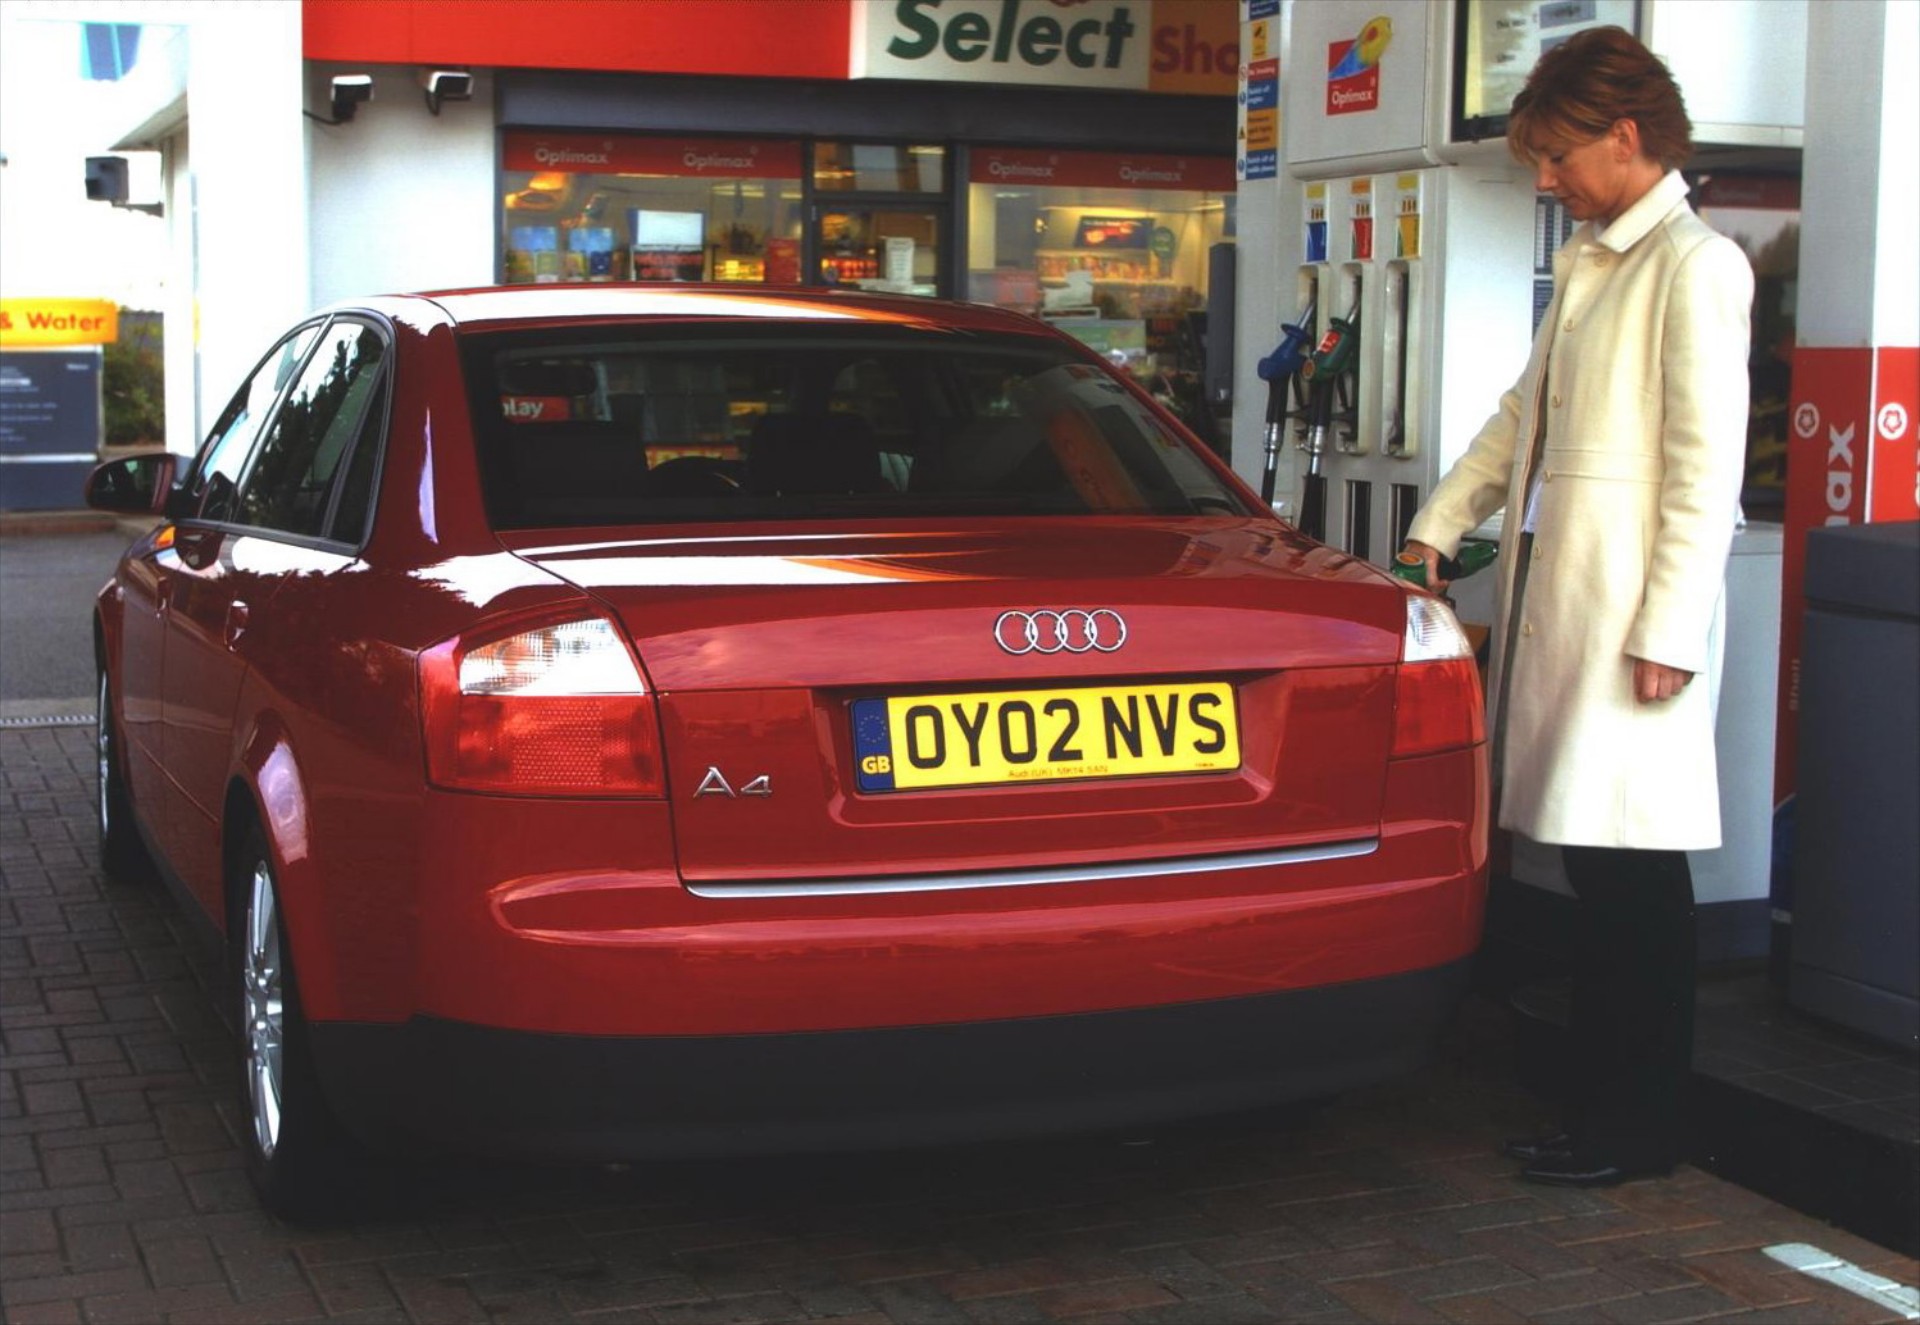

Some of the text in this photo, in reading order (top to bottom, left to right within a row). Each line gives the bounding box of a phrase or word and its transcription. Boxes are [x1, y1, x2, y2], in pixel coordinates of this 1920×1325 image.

[887, 0, 1134, 69] Select
[1331, 89, 1373, 108] Optimax
[534, 147, 608, 166] Optimax
[683, 152, 754, 169] Optimax
[988, 162, 1054, 179] Optimax
[1118, 166, 1182, 183] Optimax
[27, 312, 105, 332] Water
[1825, 421, 1855, 528] ax
[905, 692, 1226, 770] OY02 NVS
[862, 755, 891, 775] GB
[693, 766, 773, 799] A4
